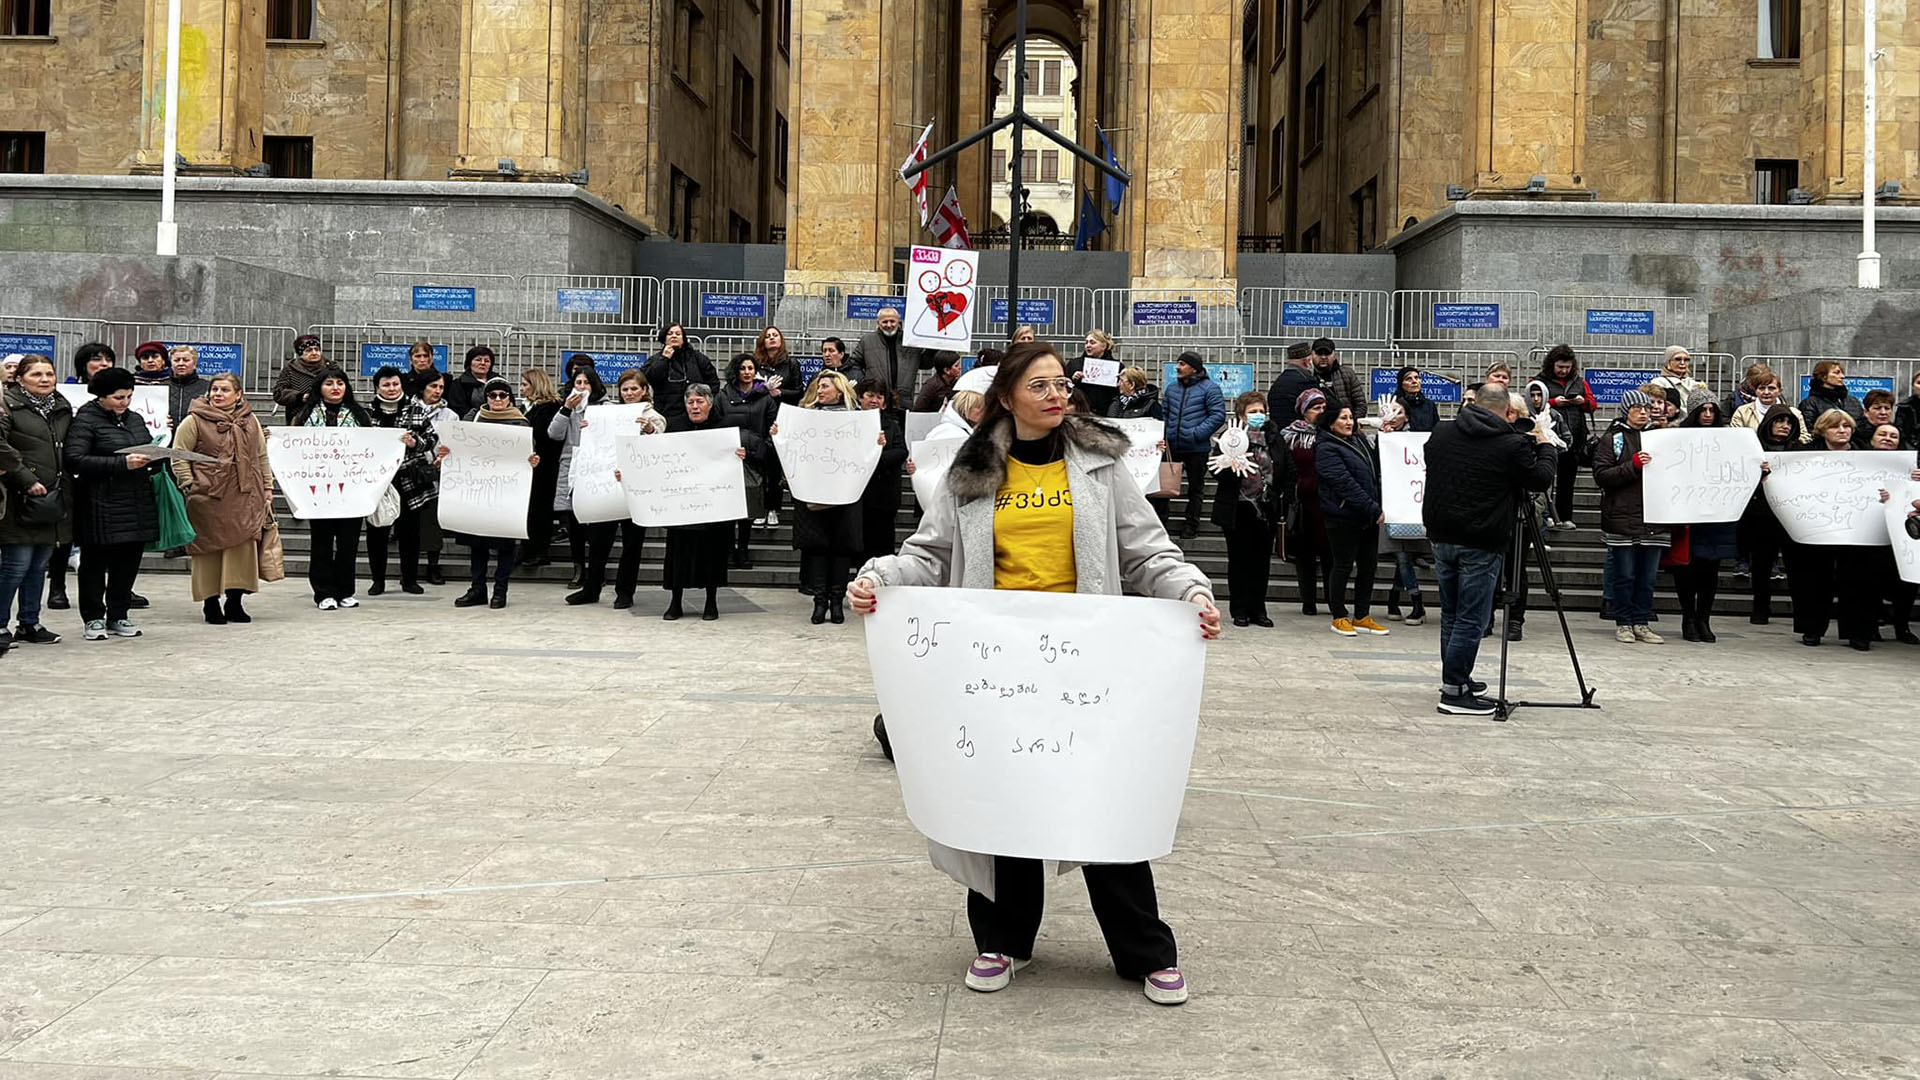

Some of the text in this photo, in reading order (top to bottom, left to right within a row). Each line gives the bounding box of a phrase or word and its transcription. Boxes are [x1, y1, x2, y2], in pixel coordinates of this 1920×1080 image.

[282, 433, 350, 449] მოიხსნას
[907, 617, 1080, 663] შენ იცი შენი
[965, 679, 1110, 705] დაბადების დღე!
[956, 725, 1075, 758] მე არა!
